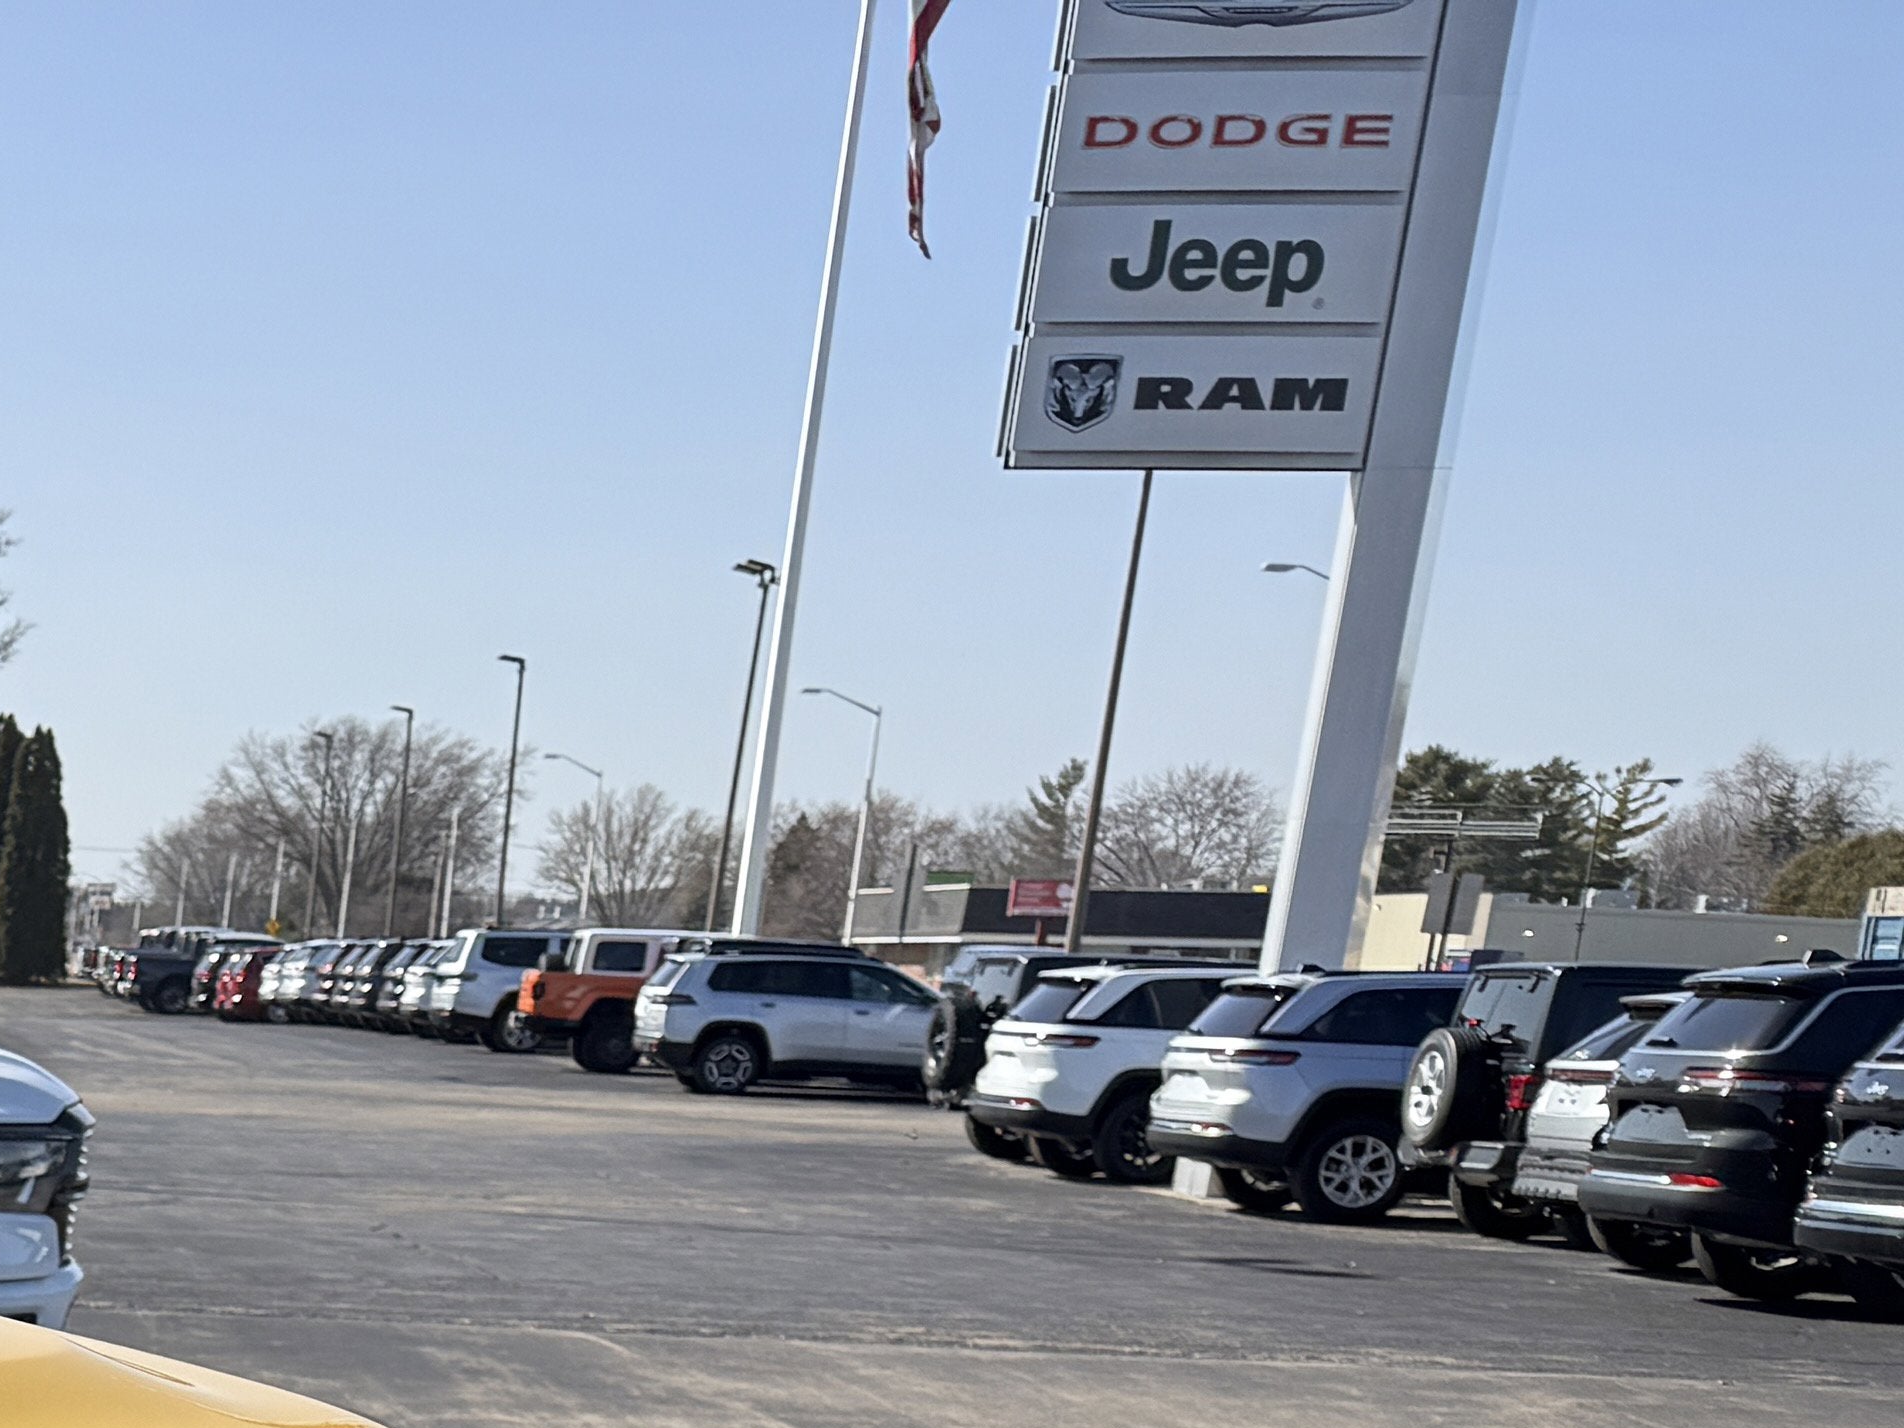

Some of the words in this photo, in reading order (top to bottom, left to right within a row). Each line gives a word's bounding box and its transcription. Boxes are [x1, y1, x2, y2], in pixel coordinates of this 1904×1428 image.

[1081, 113, 1394, 151] DODGE
[1109, 219, 1325, 308] Jeep
[1133, 376, 1349, 412] RAM
